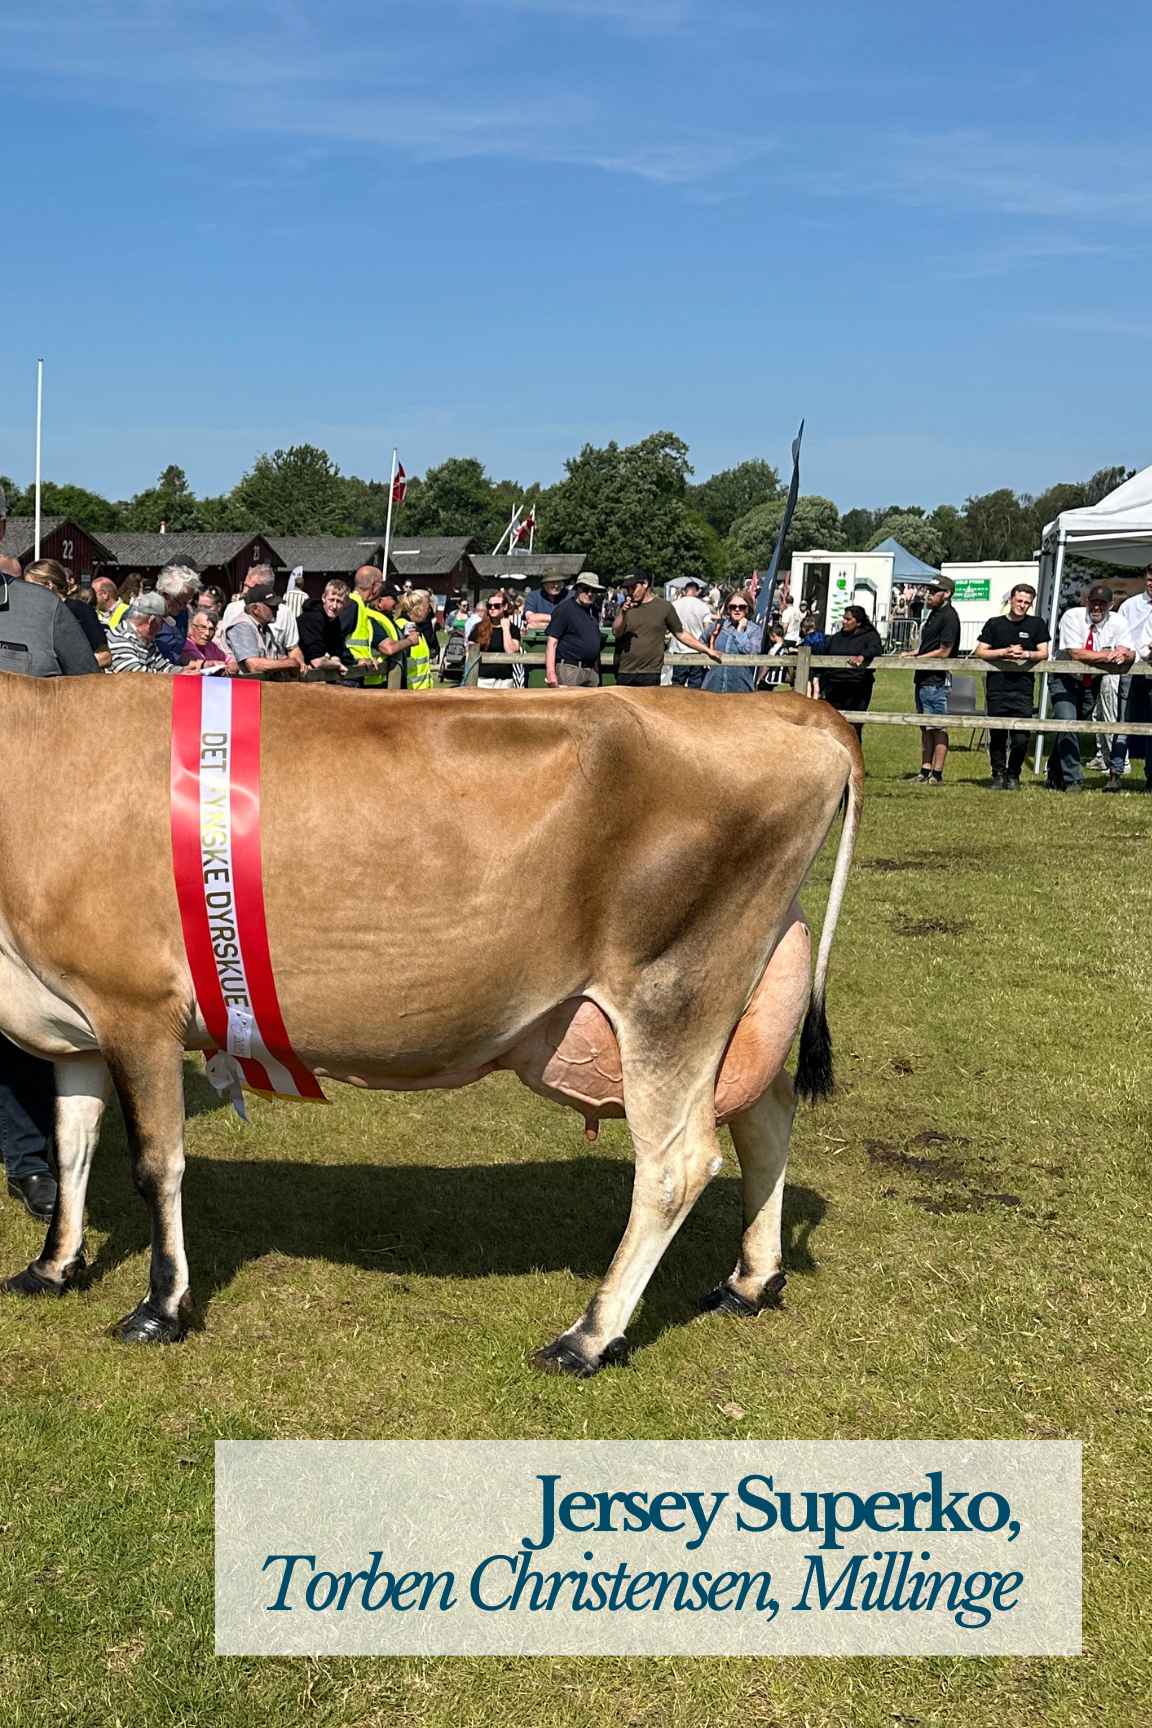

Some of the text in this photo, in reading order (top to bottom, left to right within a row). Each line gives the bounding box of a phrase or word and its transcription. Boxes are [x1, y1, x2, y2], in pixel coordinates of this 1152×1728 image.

[62, 539, 74, 560] 22
[200, 732, 228, 773] DET
[200, 779, 230, 884] YNSKE
[205, 891, 250, 1007] DYRSKUE
